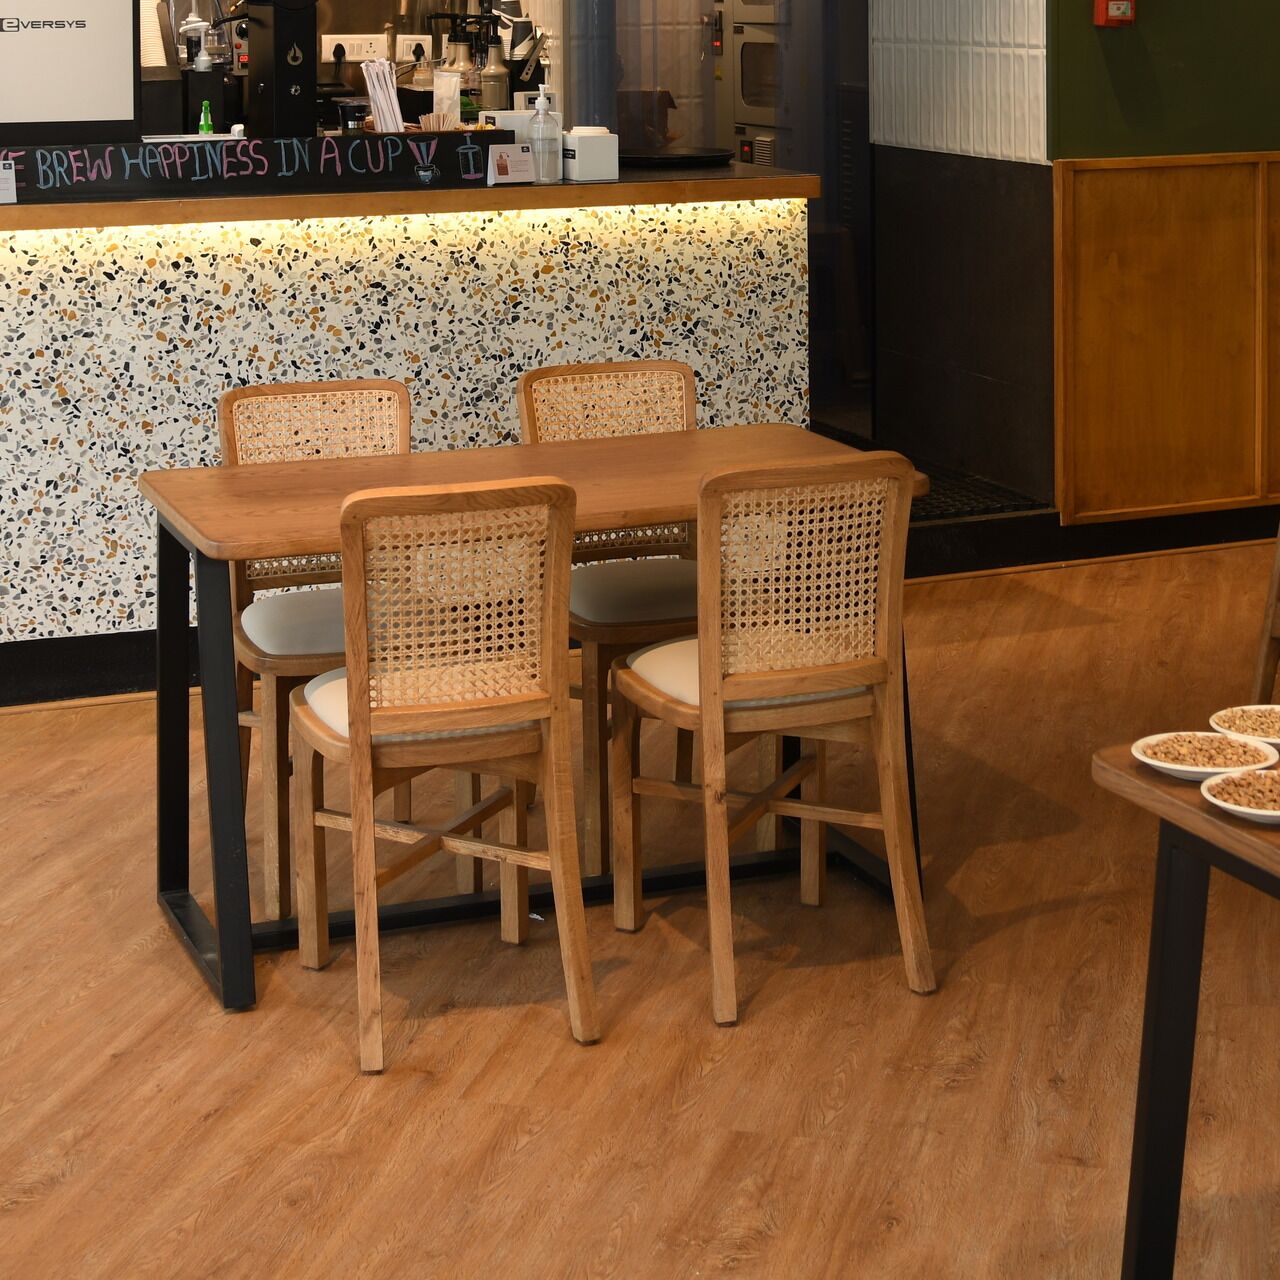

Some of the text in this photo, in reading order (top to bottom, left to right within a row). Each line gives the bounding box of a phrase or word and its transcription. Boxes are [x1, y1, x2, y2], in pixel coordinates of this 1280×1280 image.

[36, 146, 114, 189] BREW
[122, 140, 269, 180] HAPPINESS
[274, 136, 311, 177] IN
[320, 136, 342, 176] A
[349, 136, 403, 174] CUP
